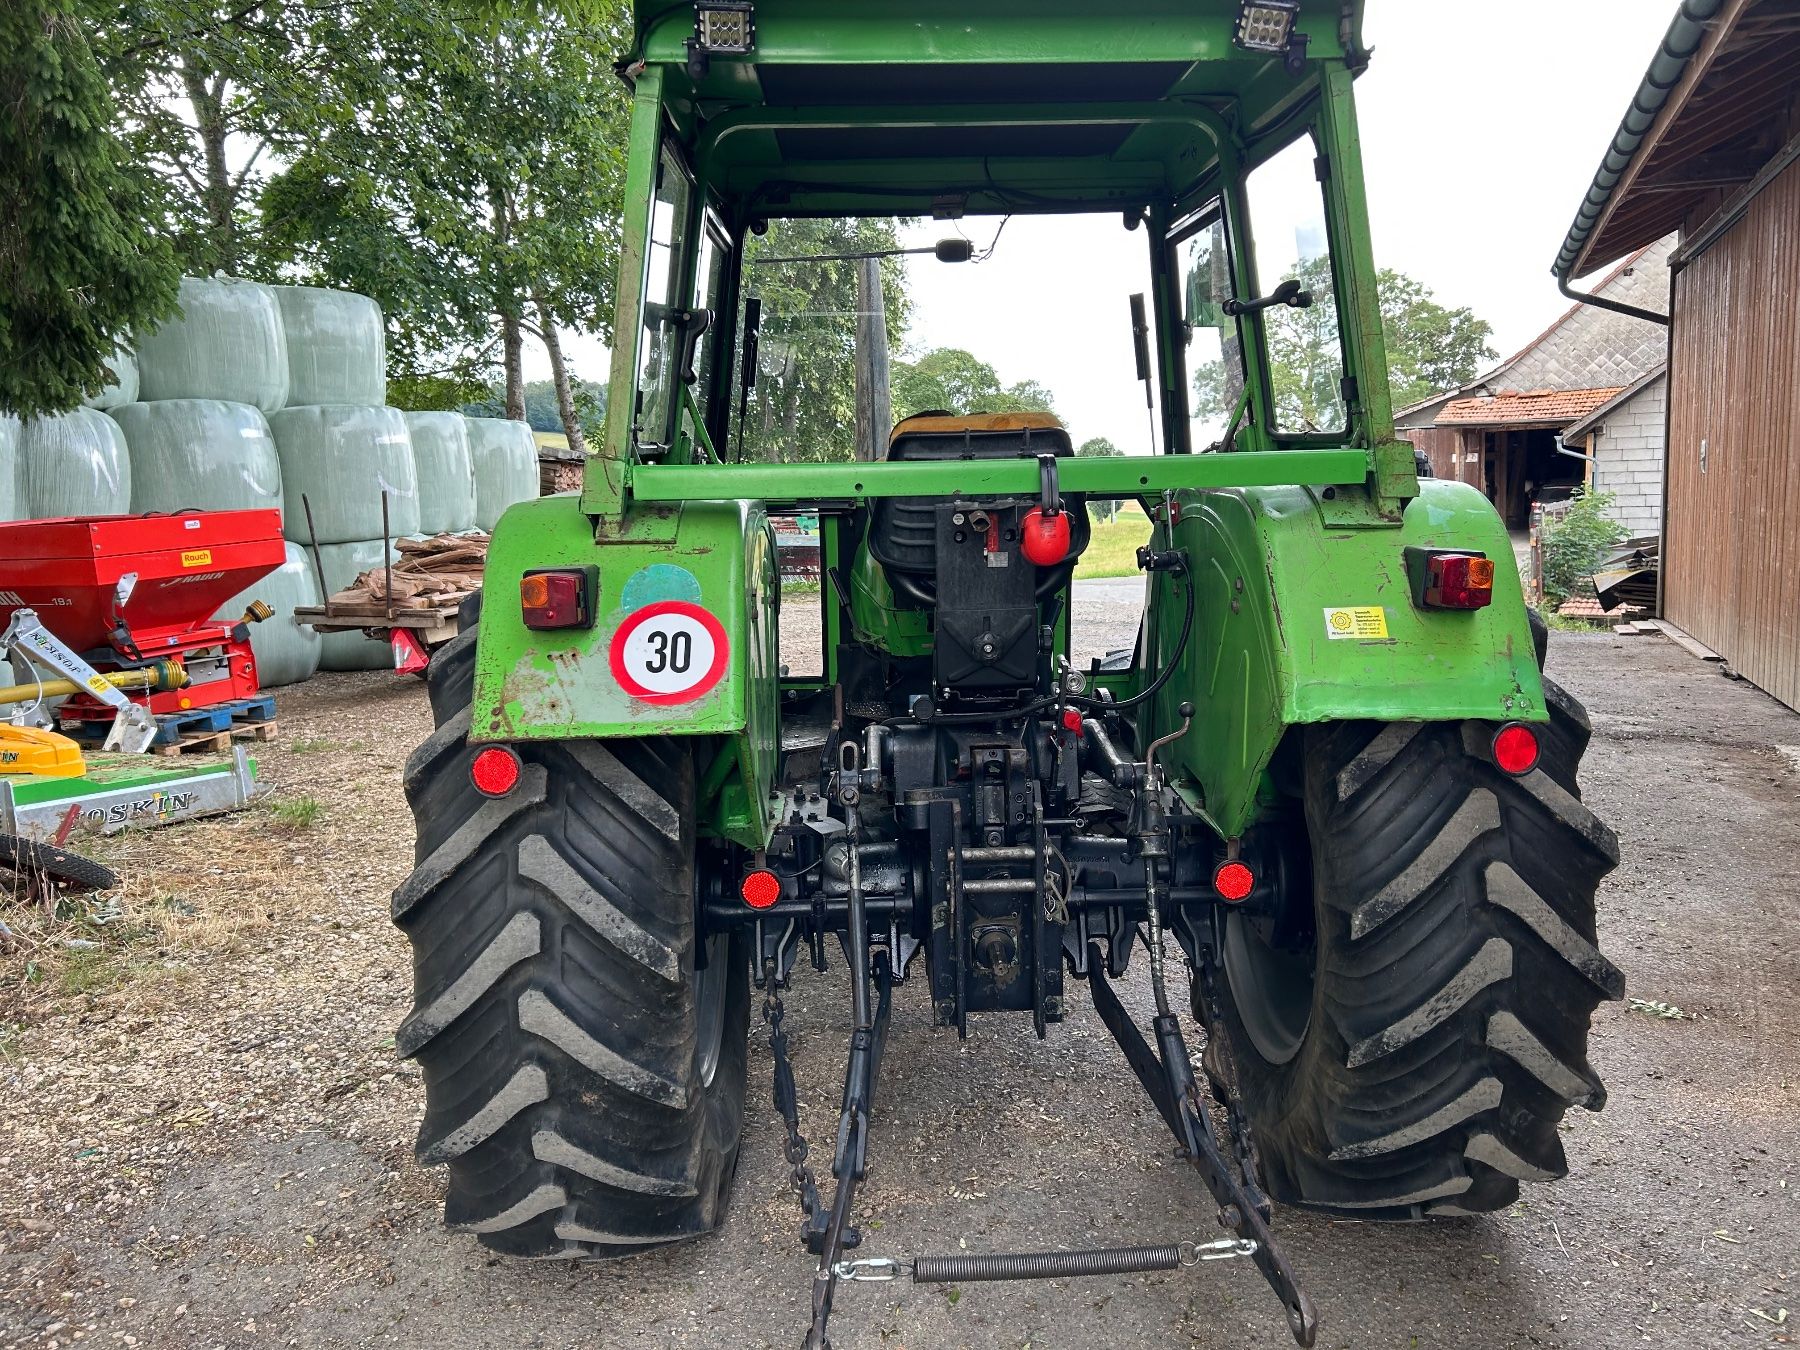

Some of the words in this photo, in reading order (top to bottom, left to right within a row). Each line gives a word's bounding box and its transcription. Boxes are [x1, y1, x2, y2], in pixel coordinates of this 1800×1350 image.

[184, 552, 209, 562] Rauch
[183, 572, 225, 583] RAUCH
[646, 631, 692, 673] 30
[72, 791, 193, 829] OSKIN
